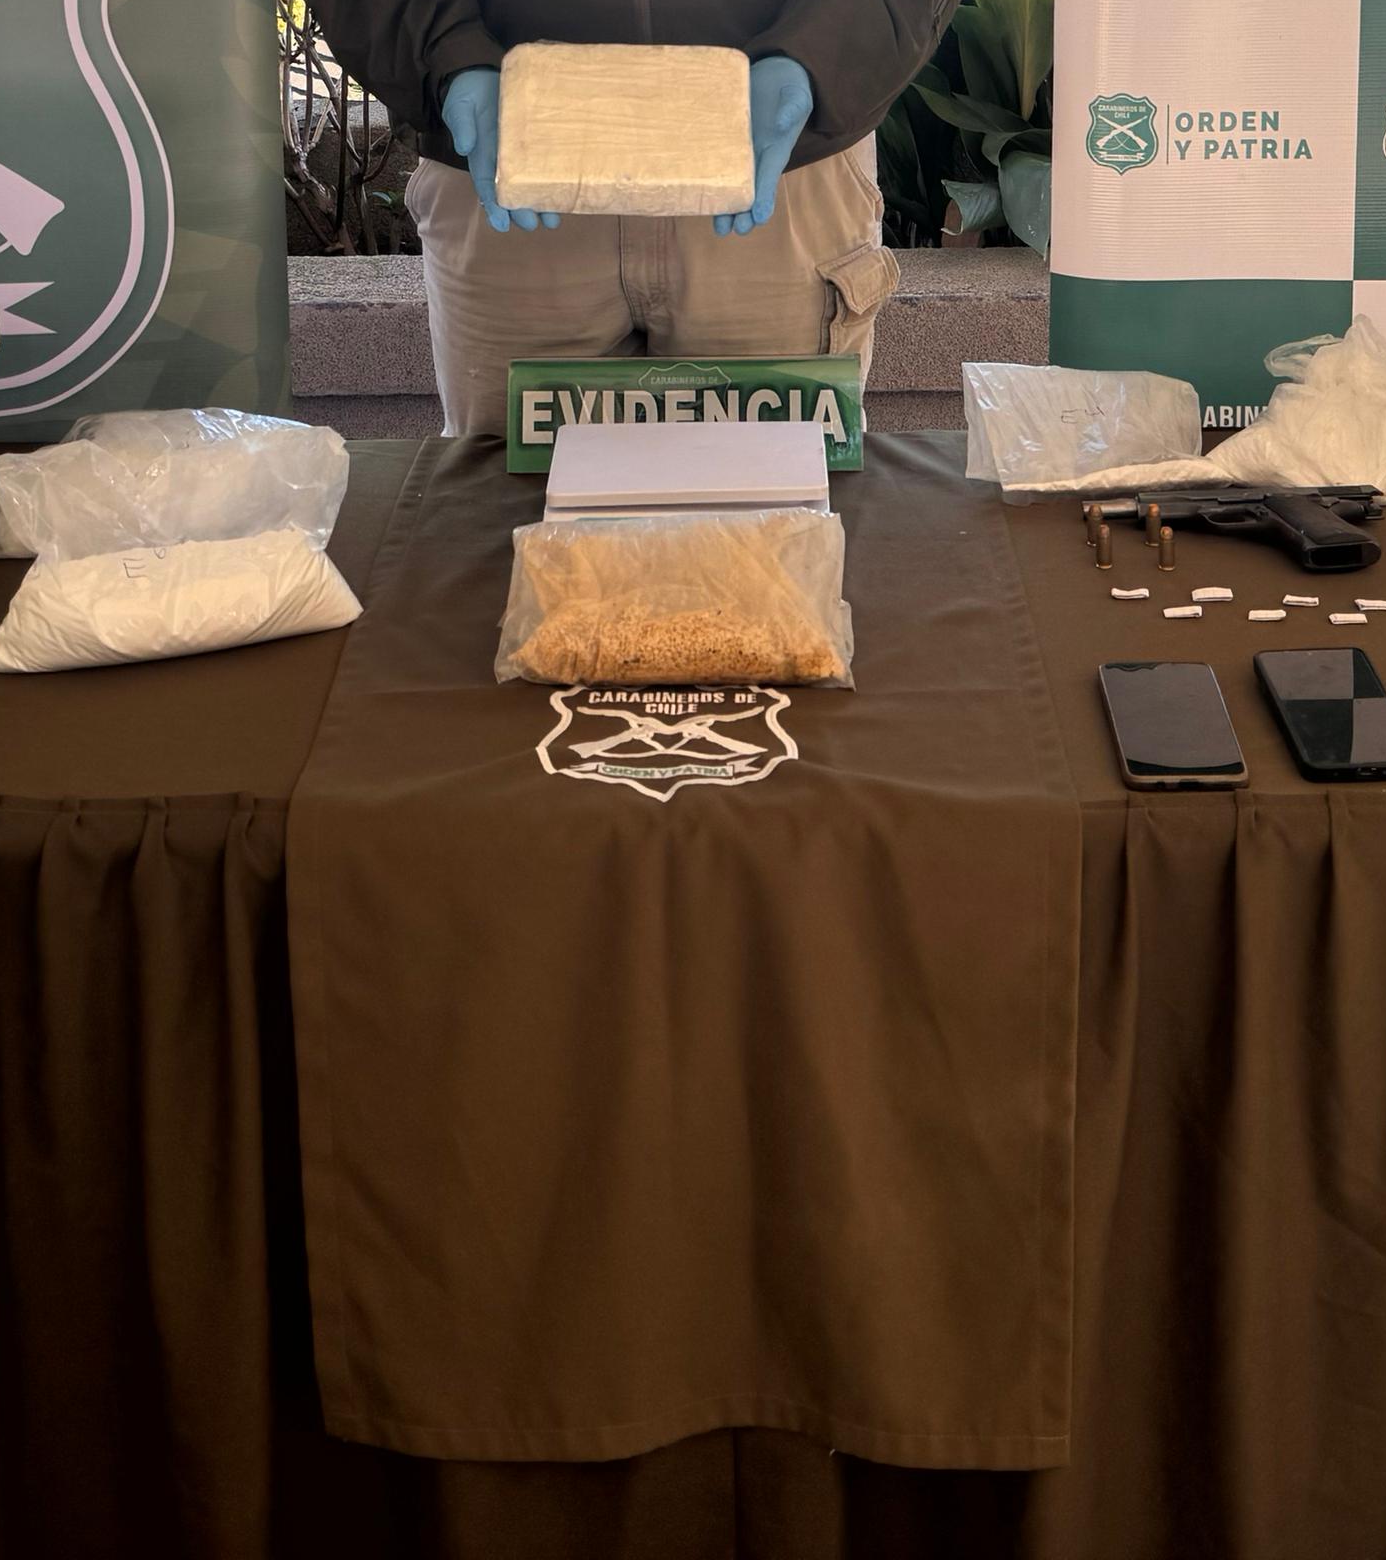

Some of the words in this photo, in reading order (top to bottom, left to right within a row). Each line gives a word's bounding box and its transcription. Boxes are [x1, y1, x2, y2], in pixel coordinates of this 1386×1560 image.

[1175, 111, 1279, 133] ORDEN
[1174, 140, 1192, 160] Y
[1204, 139, 1313, 160] PATRIA
[522, 389, 848, 444] EVIDENCIA
[1203, 405, 1269, 428] ABIN
[588, 691, 725, 705] CARABINEROS
[734, 692, 757, 704] DE
[645, 703, 698, 715] CHILE
[658, 766, 669, 778] Y
